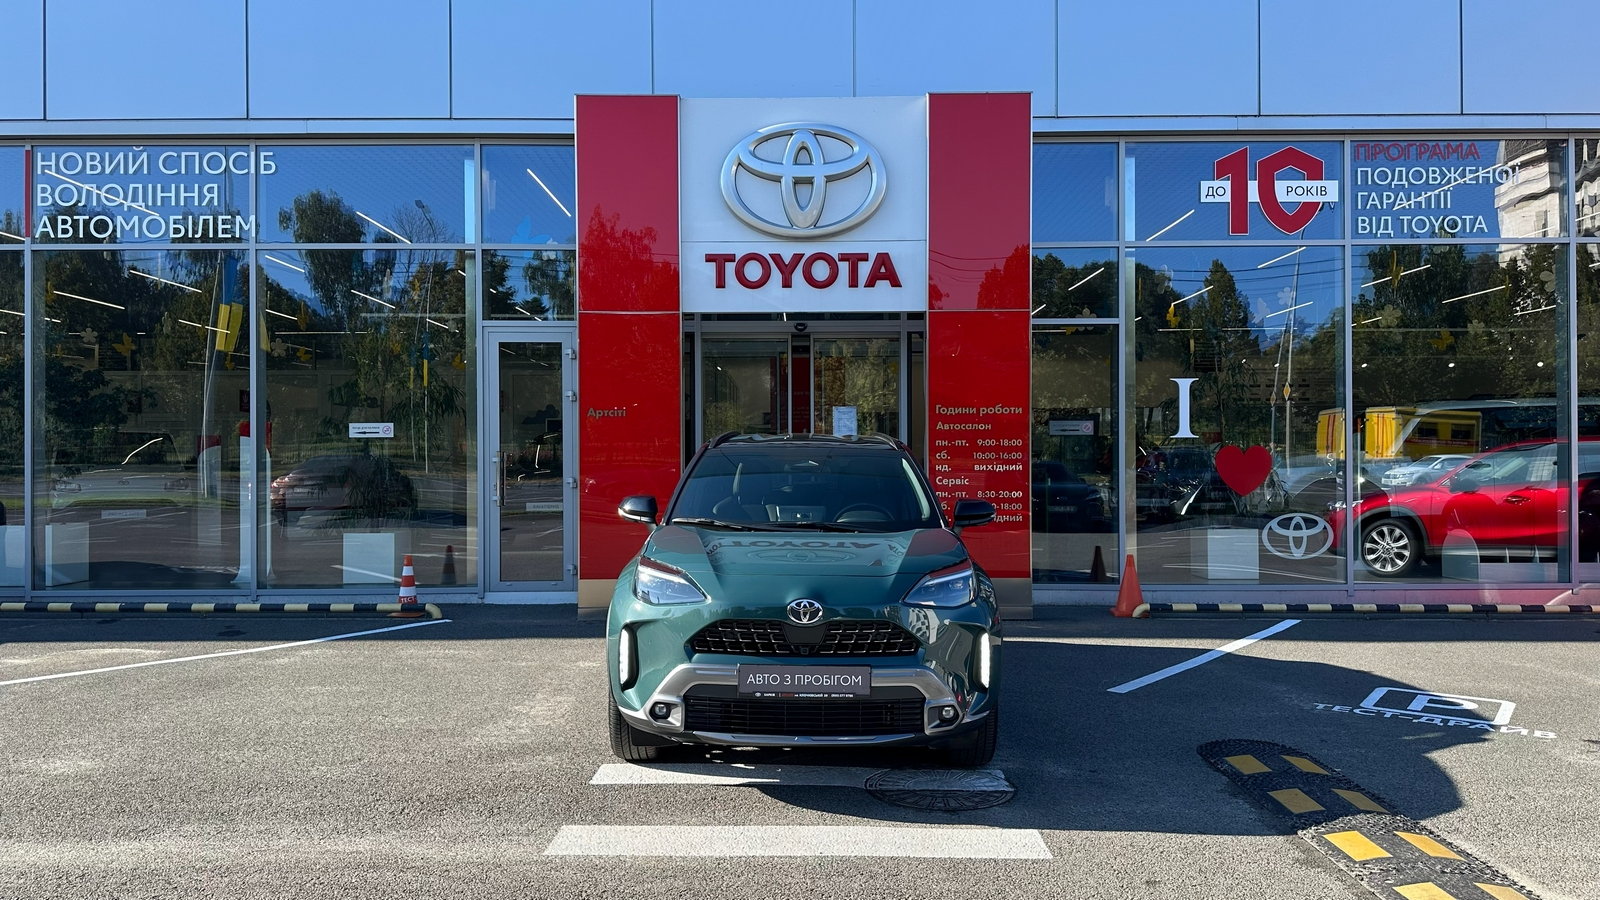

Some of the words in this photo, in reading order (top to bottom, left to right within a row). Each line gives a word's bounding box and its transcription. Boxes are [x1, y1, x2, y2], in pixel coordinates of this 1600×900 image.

[1355, 142, 1481, 161] ПРОГРАМА
[37, 146, 148, 175] НОВИЙ
[158, 151, 276, 175] СПОСІБ
[1357, 162, 1521, 188] ПОДОВЖЕНОЇ
[37, 183, 219, 211] ВОЛОДІННЯ
[1205, 186, 1227, 199] ДО
[1214, 145, 1325, 236] 10
[1286, 185, 1328, 197] РОКІВ
[1357, 187, 1453, 210] ГАРАНТІЇ
[35, 215, 257, 239] АВТОМОБІЛЕМ
[1357, 216, 1394, 238] ВІД
[1399, 215, 1489, 234] TOYOTA
[704, 252, 903, 290] TOYOTA
[587, 406, 627, 419] Артсіті
[935, 404, 977, 416] Години
[979, 404, 1023, 416] роботи
[1169, 377, 1200, 439] I
[936, 421, 992, 431] Автосалон
[976, 439, 1023, 447] 9:00-18:00
[935, 450, 951, 460] сб.
[972, 452, 1023, 460] 10:00-16:00
[935, 464, 952, 472] нд.
[974, 461, 1023, 472] вихідний
[935, 475, 970, 487] Сервіс
[976, 490, 1023, 498] 8:30-20:00
[746, 673, 780, 685] АВТО
[794, 674, 862, 686] ПРОБІГОМ
[1313, 702, 1558, 739] ТЕСТ-ДРАЙВ
